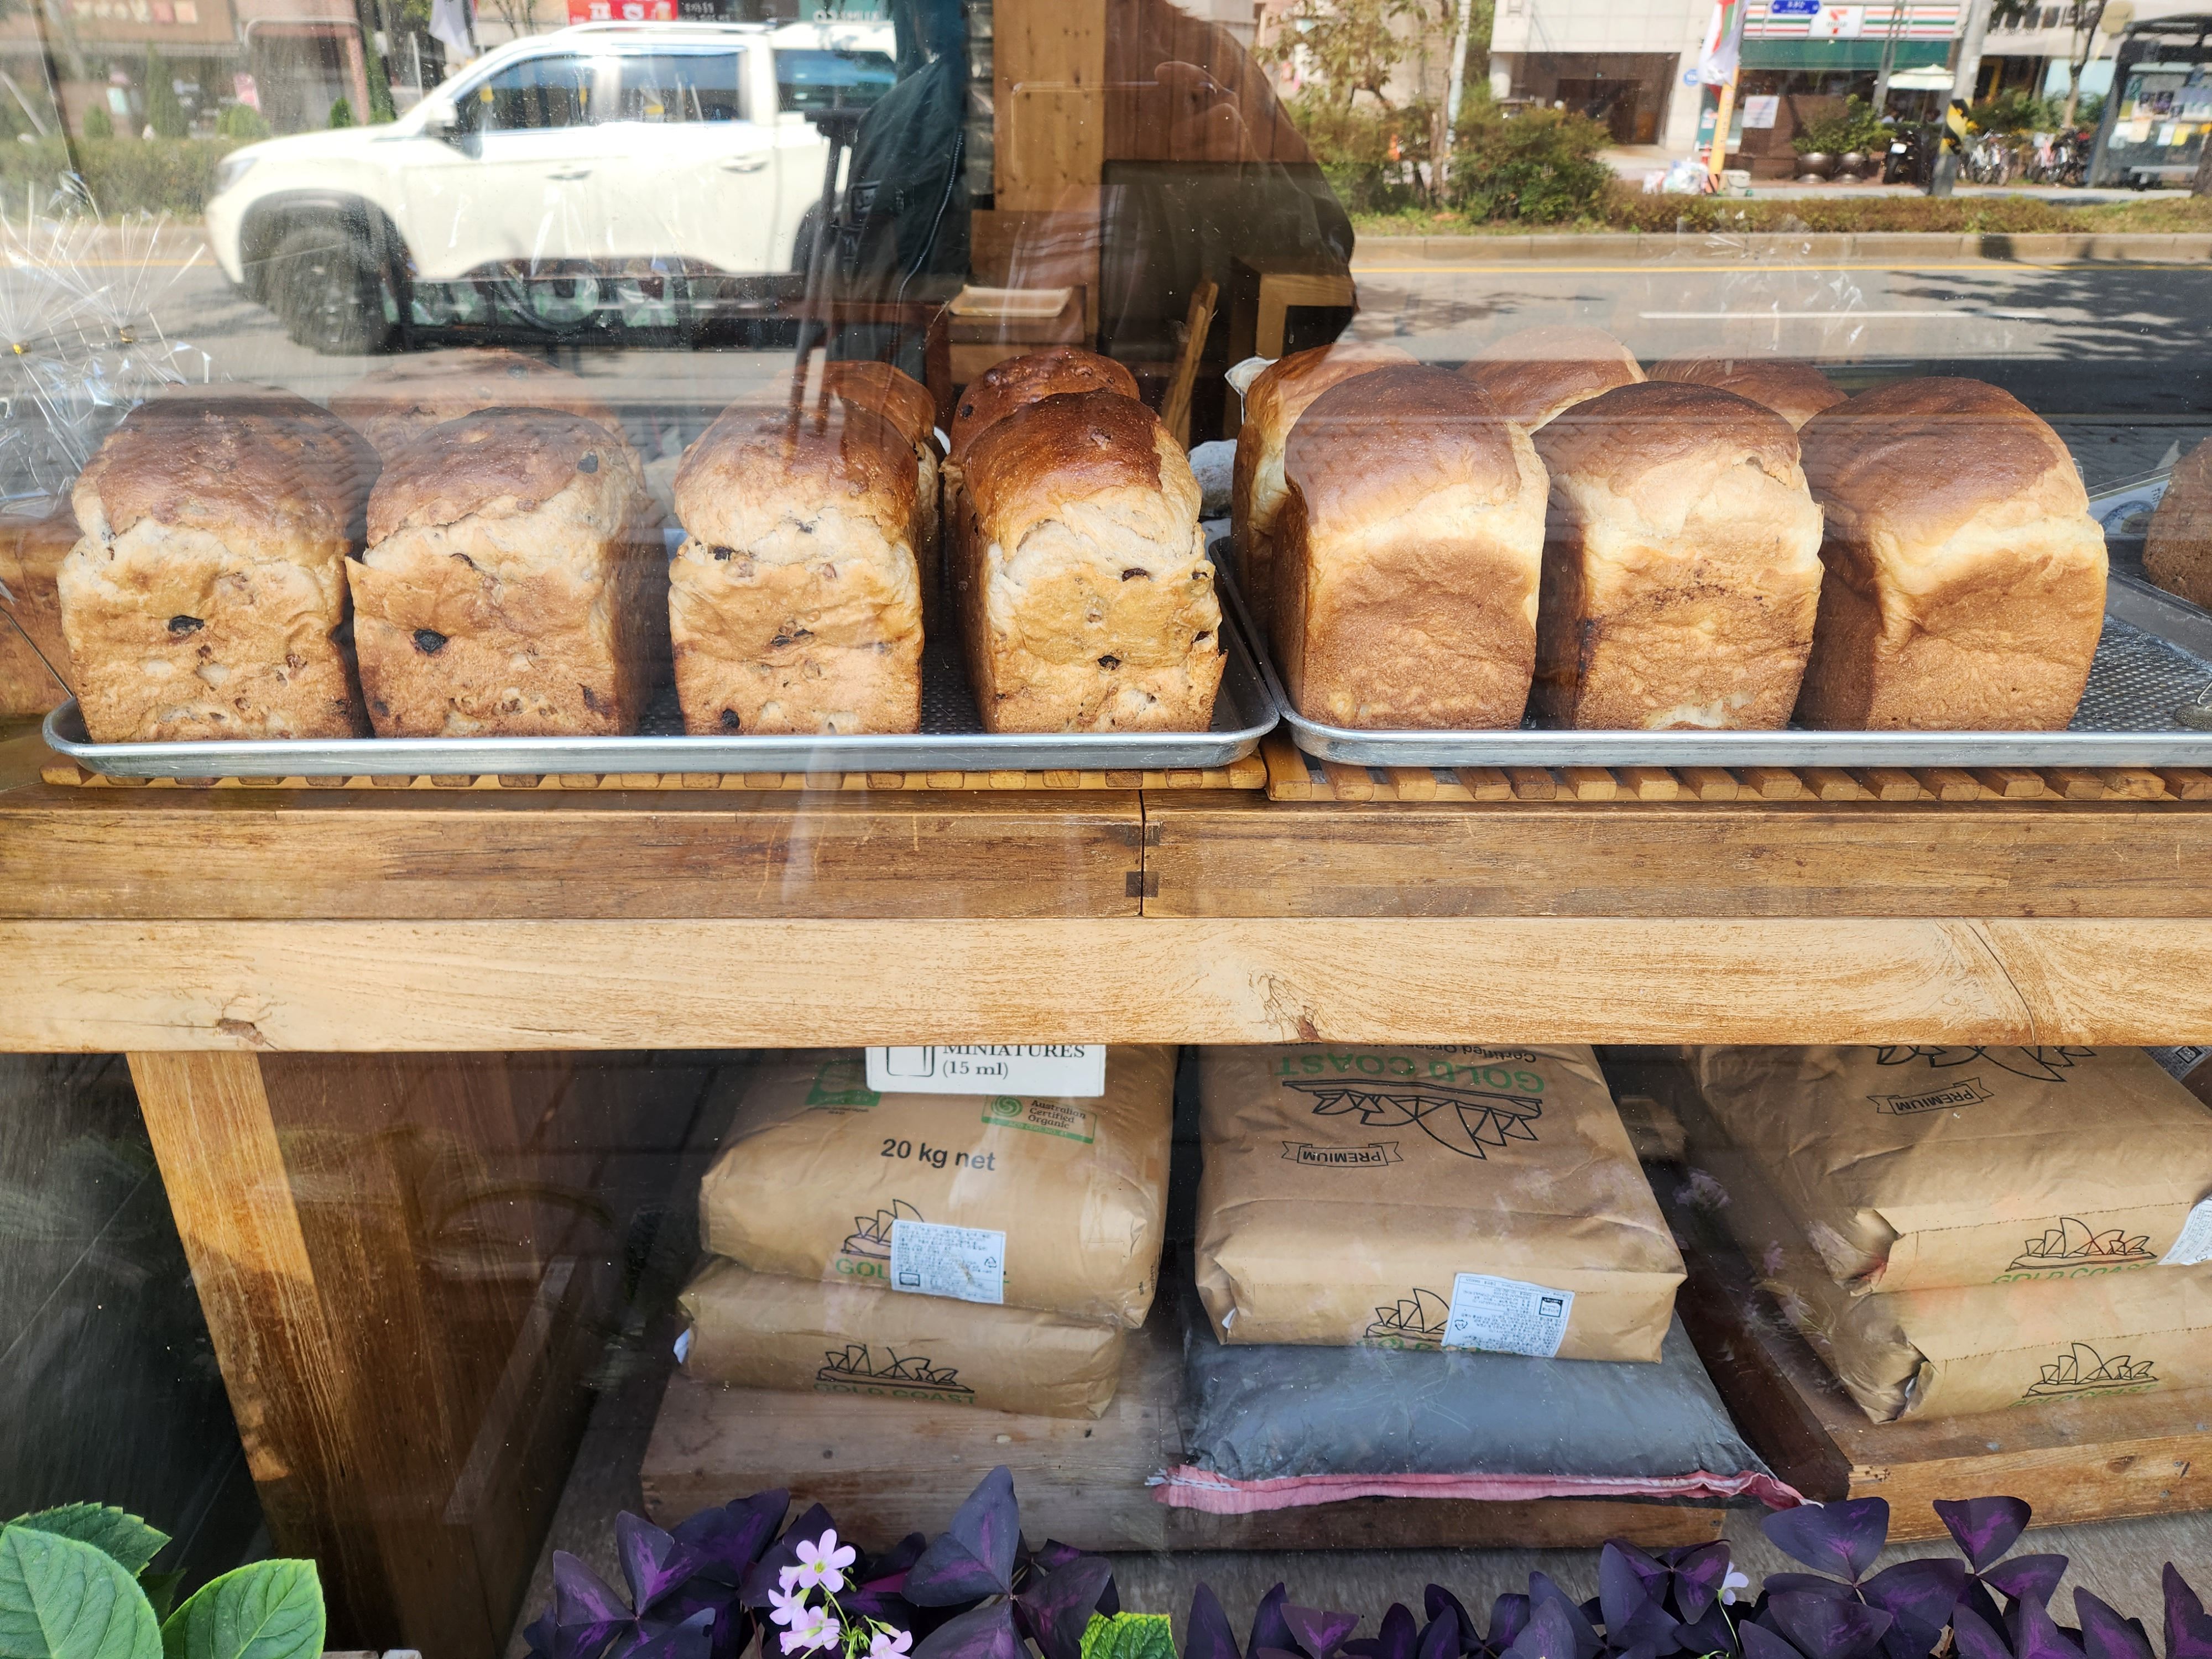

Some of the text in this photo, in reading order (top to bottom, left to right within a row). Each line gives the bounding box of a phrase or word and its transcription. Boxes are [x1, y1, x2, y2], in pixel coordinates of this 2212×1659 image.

[943, 1045, 1085, 1057] MINIATURES
[1463, 1045, 1537, 1063] Certified
[943, 1060, 1009, 1079] (15 ml)
[1274, 1052, 1545, 1093] GOLD COAST
[1031, 1100, 1086, 1119] Australian
[1895, 1089, 1974, 1111] PREMIUM
[1028, 1114, 1070, 1129] Organic
[1029, 1107, 1074, 1123] Certified
[880, 1138, 995, 1171] 20 kg net
[1303, 1151, 1381, 1163] PREMIUM
[835, 1258, 890, 1280] GOL
